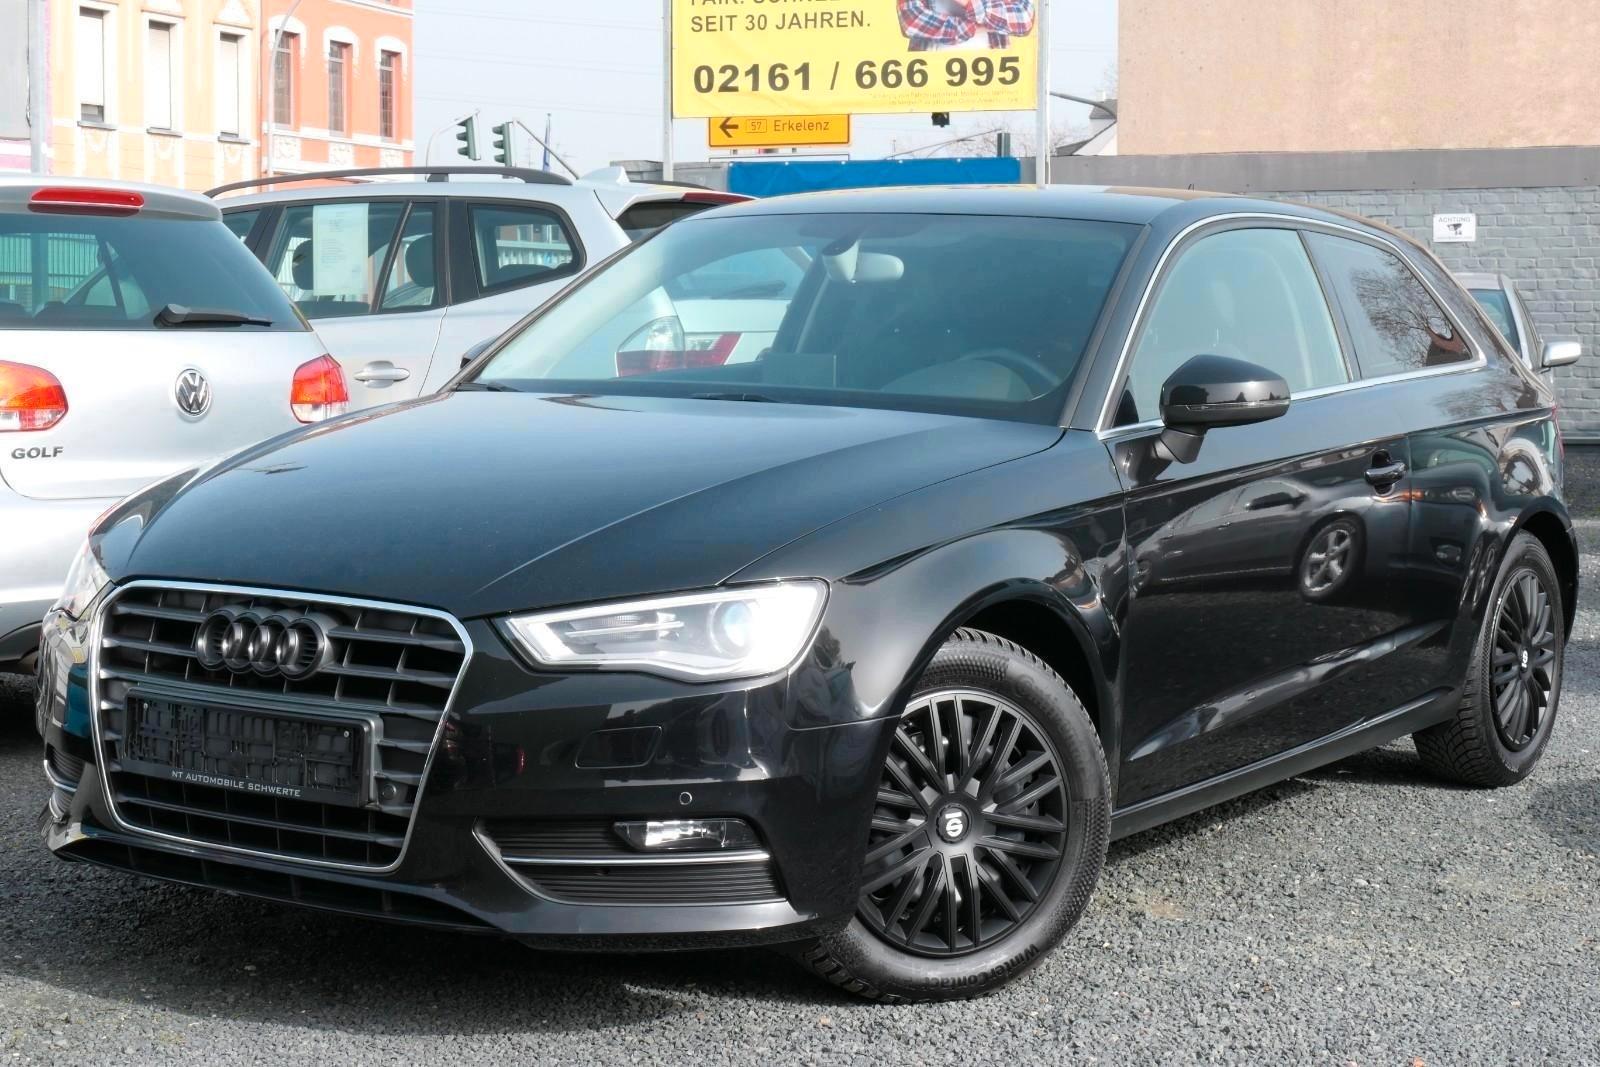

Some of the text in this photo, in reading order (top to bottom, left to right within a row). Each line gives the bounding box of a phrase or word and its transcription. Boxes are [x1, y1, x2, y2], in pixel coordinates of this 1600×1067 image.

[691, 10, 871, 32] SEIT 30 JAHREN.
[694, 56, 1020, 93] 02161 / 666 995
[751, 120, 830, 132] 57 Erkelenz
[11, 446, 64, 460] GOLF
[171, 770, 301, 797] NT AUTOMOBILE SCHWERTE
